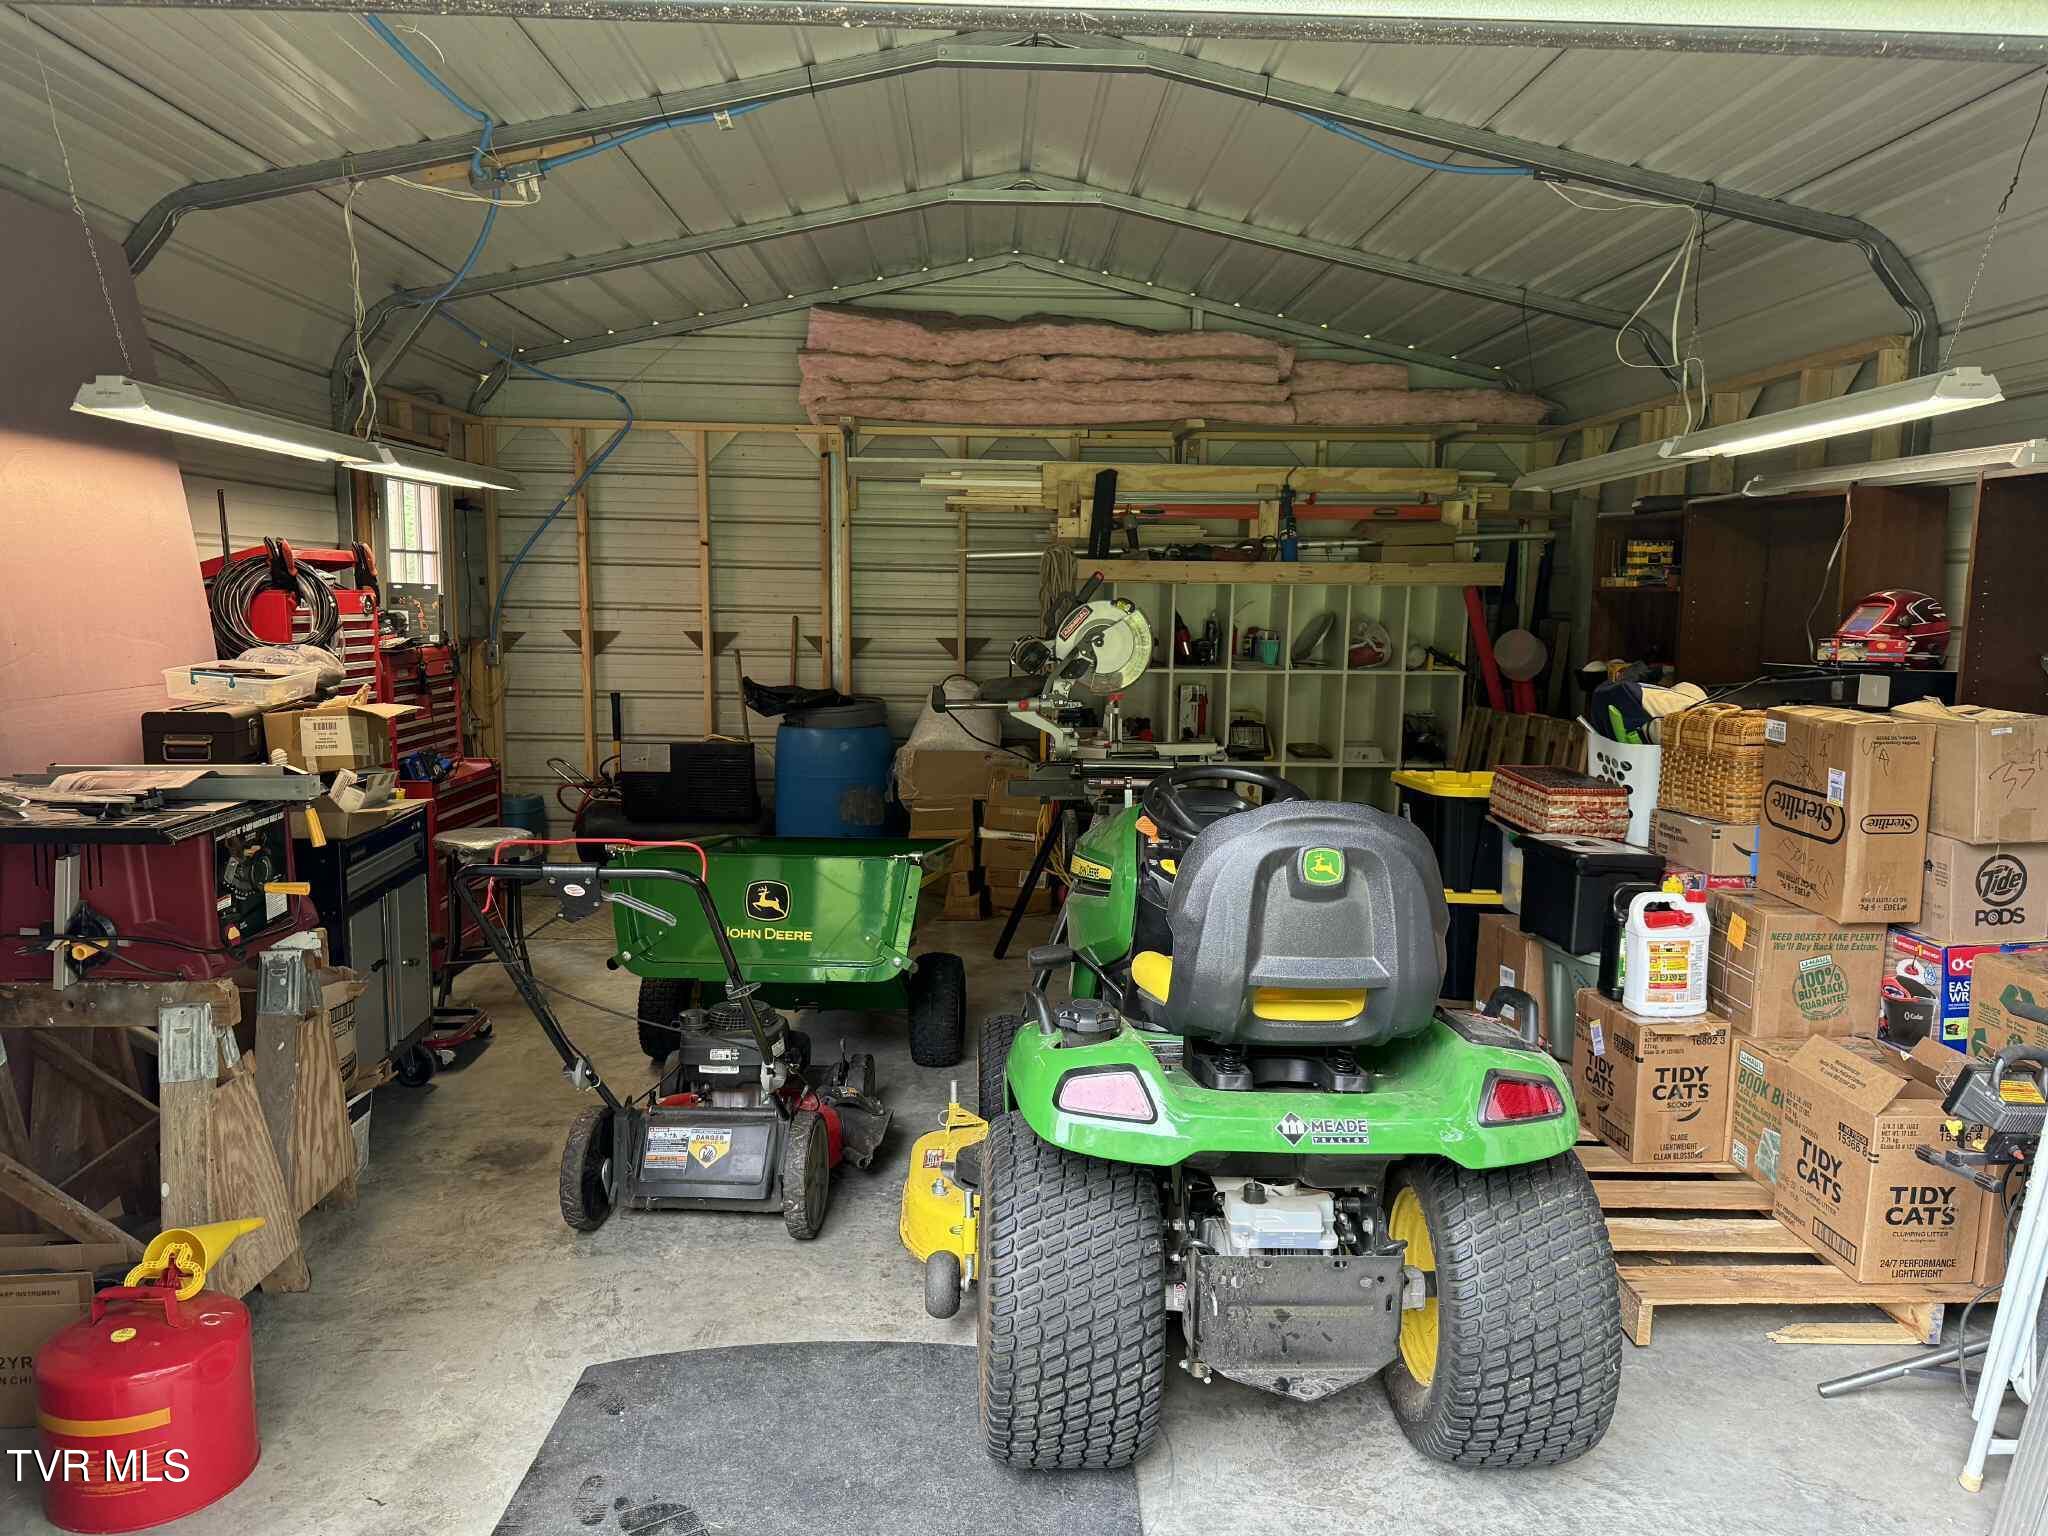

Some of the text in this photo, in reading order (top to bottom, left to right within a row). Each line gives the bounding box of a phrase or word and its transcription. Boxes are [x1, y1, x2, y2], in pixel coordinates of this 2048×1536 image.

[1773, 791, 1835, 831] Sterilite
[1866, 818, 1913, 830] Sterilite
[1980, 865, 2023, 897] Tide
[1975, 907, 2026, 926] PODS
[764, 928, 813, 941] DEERE
[1771, 932, 1883, 941] NEED BOXES? TAKE PLENTY!
[1795, 943, 1811, 952] Buy
[1813, 943, 1834, 951] Back
[1836, 943, 1848, 951] the
[1799, 966, 1841, 990] 100%
[1798, 982, 1844, 1001] BUY-BACK
[1800, 994, 1847, 1010] GUARANTEE
[1587, 1050, 1614, 1075] TIDY
[1585, 1066, 1615, 1097] CATS
[1655, 1066, 1709, 1083] TIDY
[1652, 1084, 1710, 1101] CATS
[1738, 1069, 1770, 1100] BOOK
[1312, 1120, 1367, 1132] MEADE
[1660, 1142, 1698, 1151] LIGHTWEIGHT
[1653, 1152, 1671, 1160] CLEAN
[1800, 1136, 1843, 1178] TIDY
[1796, 1158, 1842, 1203] CATS
[1890, 1186, 1956, 1205] TIDY
[1885, 1207, 1956, 1225] CATS
[1880, 1258, 1957, 1268] 24/7 PERFORMANCE
[1892, 1269, 1943, 1278] LIGHTWEIGHT
